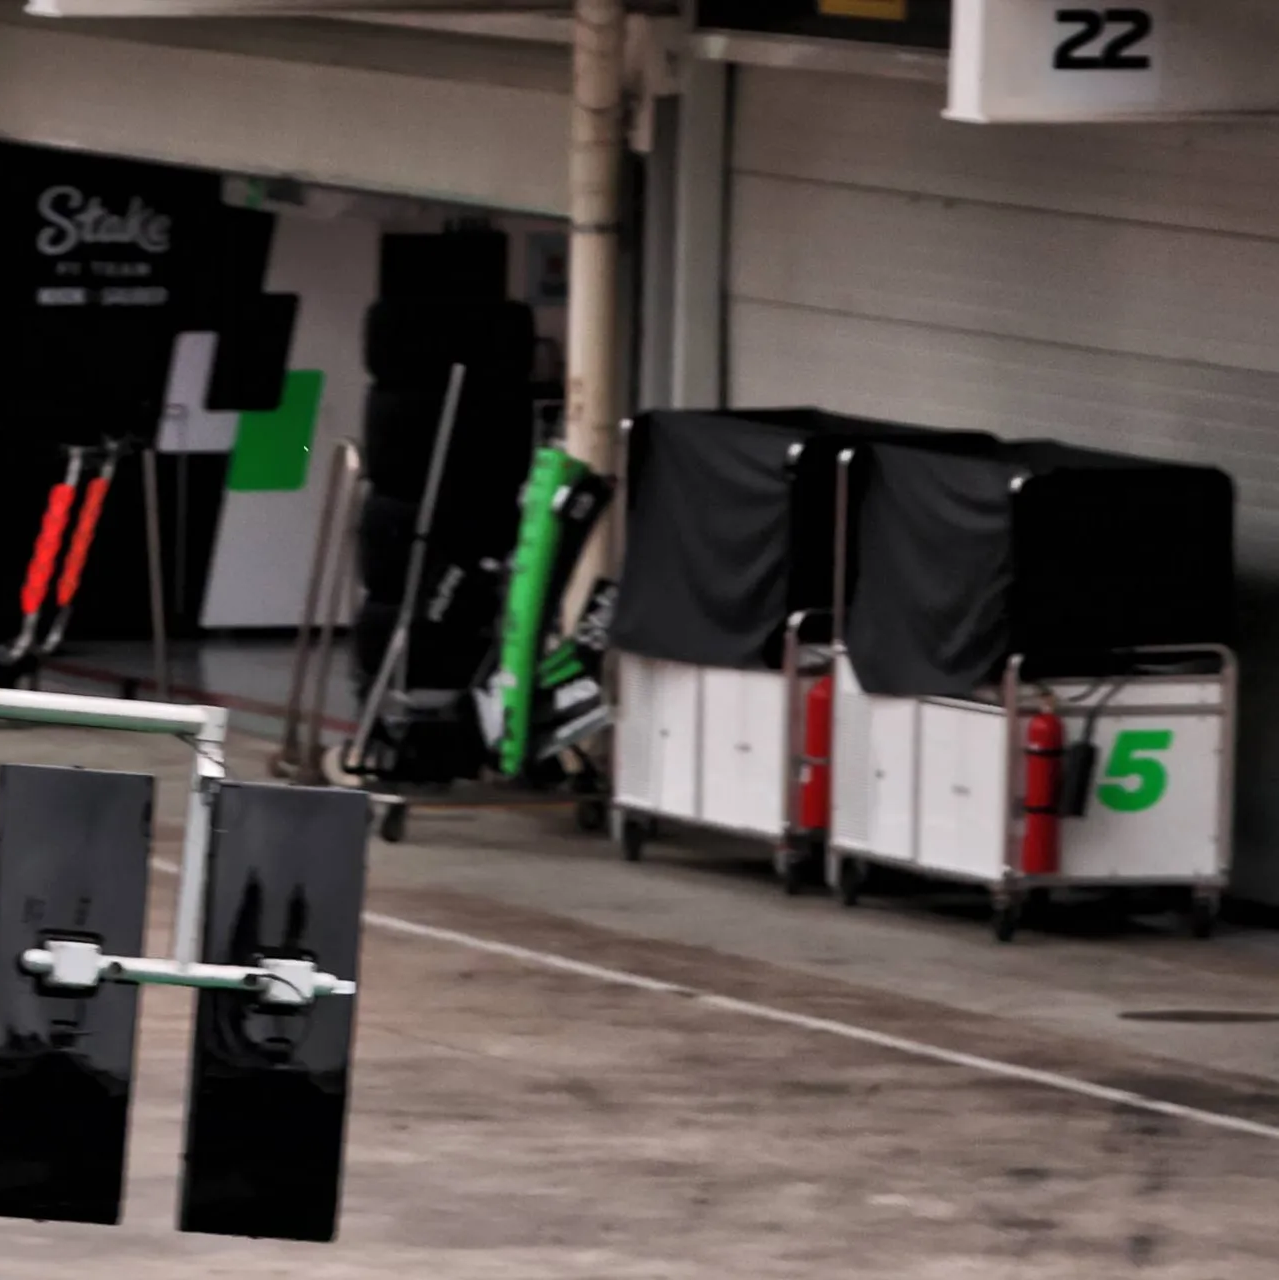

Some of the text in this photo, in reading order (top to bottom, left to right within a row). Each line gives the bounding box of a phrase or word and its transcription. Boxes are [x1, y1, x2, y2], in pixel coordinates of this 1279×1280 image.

[1052, 10, 1152, 70] 22
[36, 185, 172, 255] Stake
[1096, 729, 1174, 811] 5
